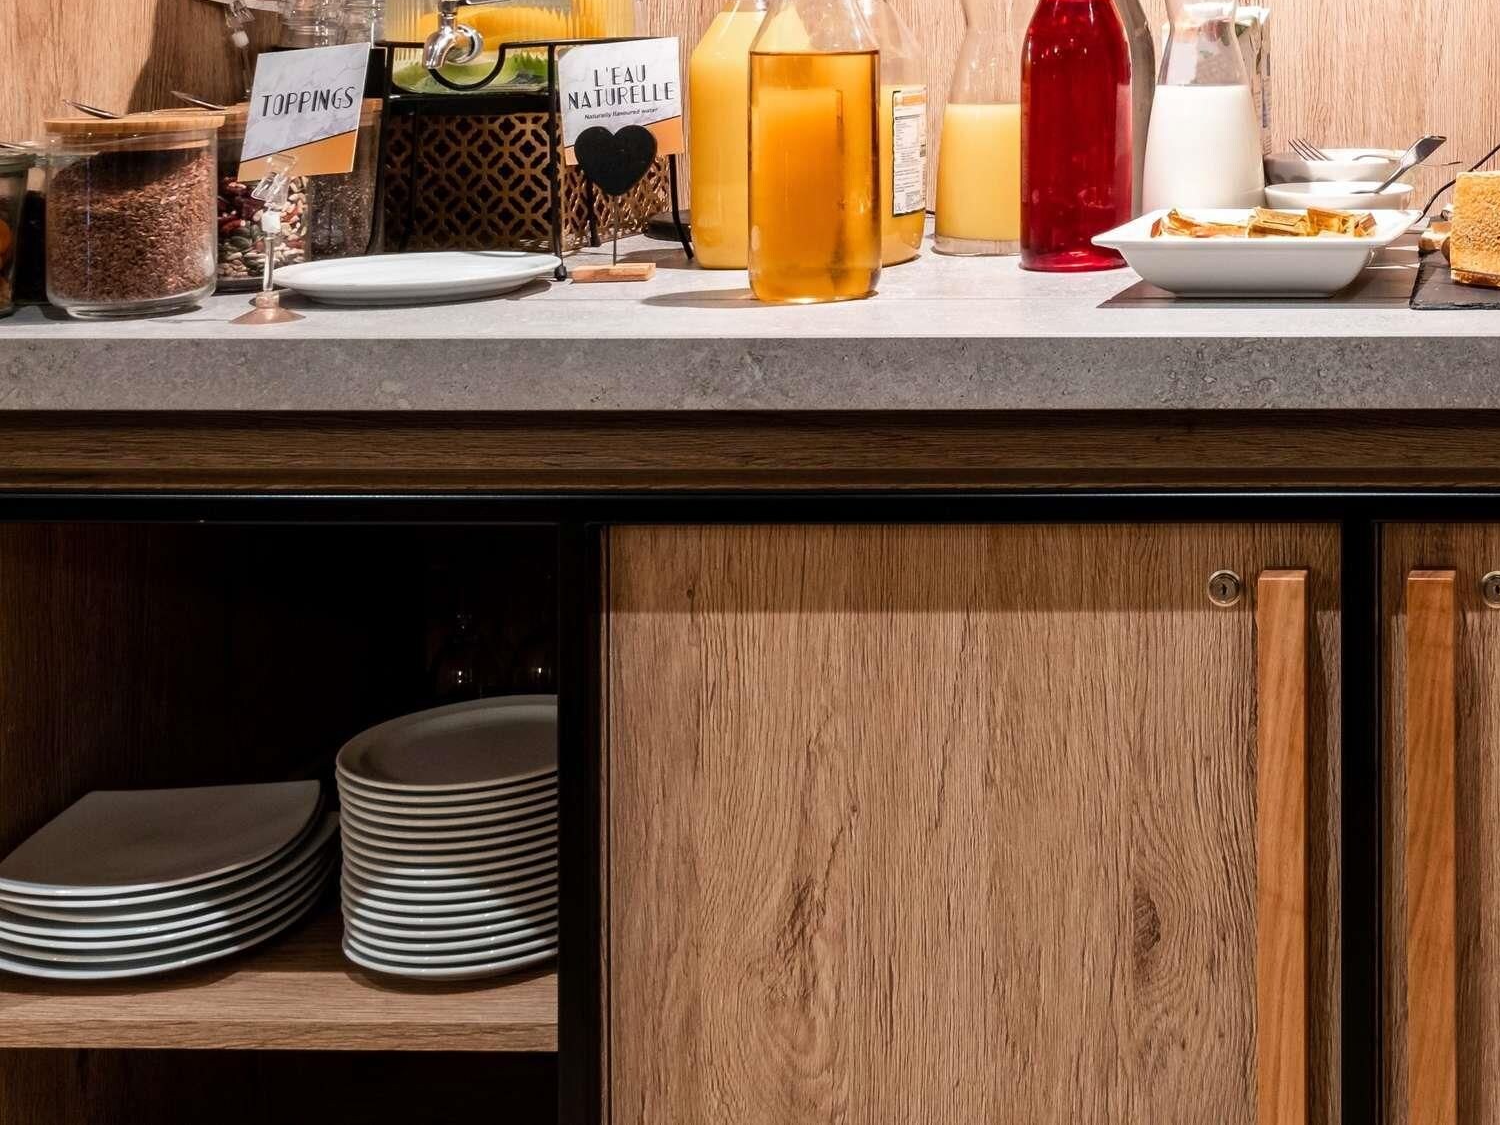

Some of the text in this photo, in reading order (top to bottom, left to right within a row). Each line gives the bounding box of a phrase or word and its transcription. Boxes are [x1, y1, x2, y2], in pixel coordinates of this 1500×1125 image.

[593, 64, 647, 88] L'EAU
[260, 86, 356, 117] TOPPINGS
[567, 81, 676, 111] NATURELLE
[584, 111, 612, 121] Naturally
